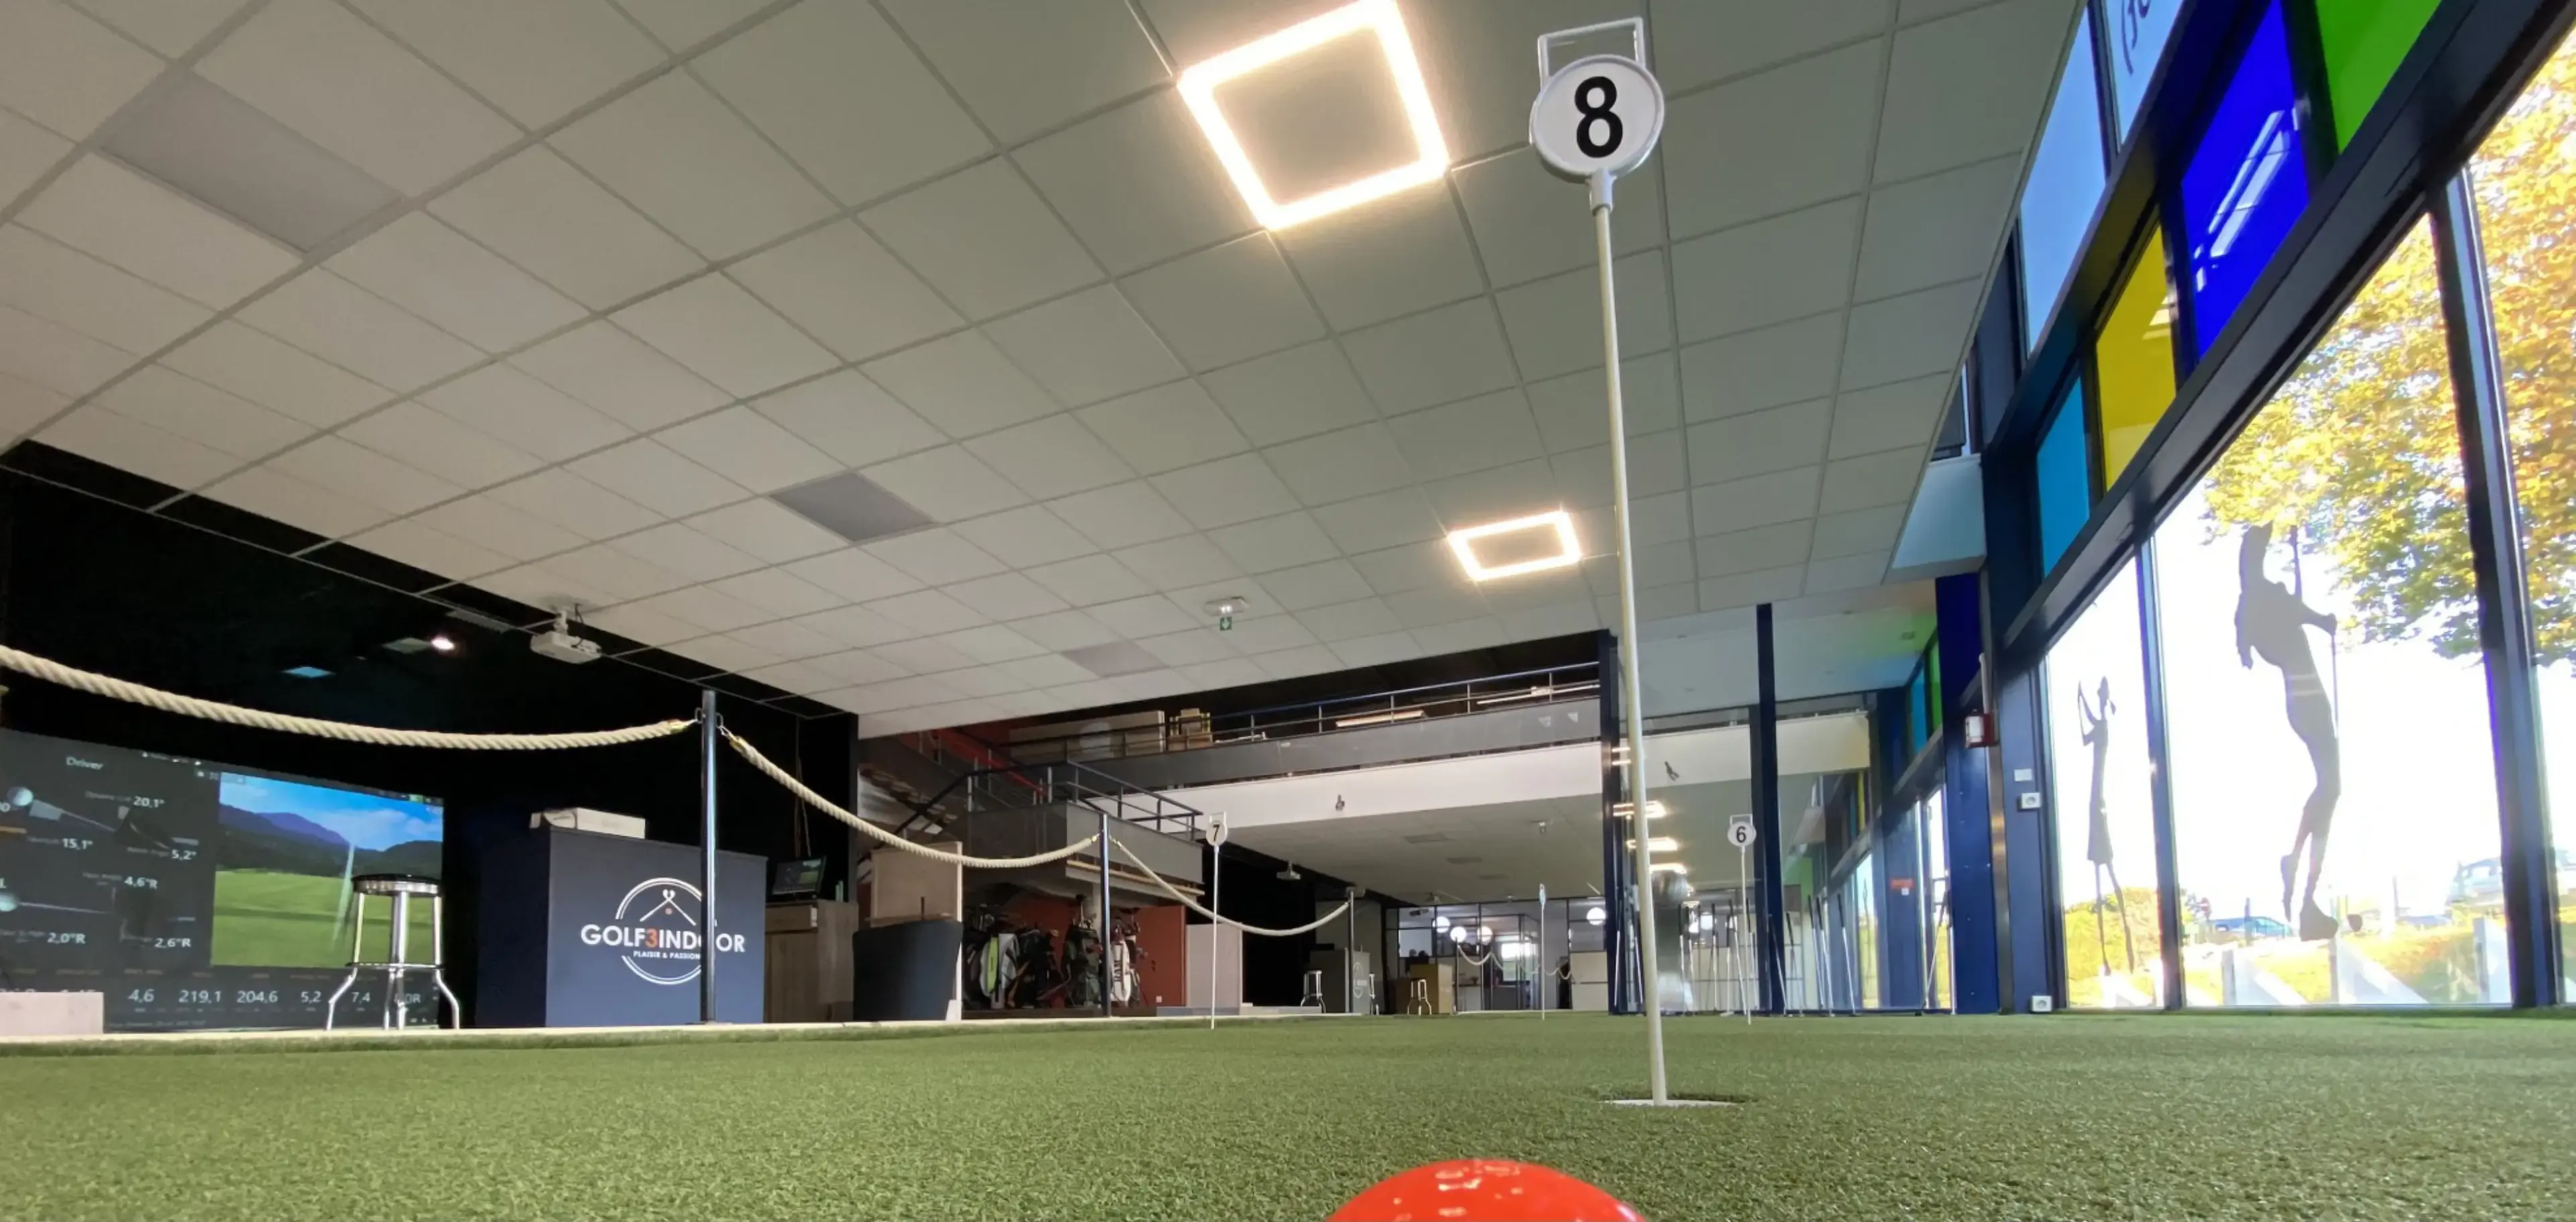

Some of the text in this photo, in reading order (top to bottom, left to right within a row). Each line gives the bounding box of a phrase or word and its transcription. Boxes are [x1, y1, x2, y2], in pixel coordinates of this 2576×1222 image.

[1574, 76, 1623, 158] 8
[66, 757, 103, 770] Driver
[1213, 824, 1220, 842] 7
[1736, 826, 1746, 843] 6
[581, 924, 745, 952] GOLF3INDOR
[633, 950, 661, 958] PLAISIR
